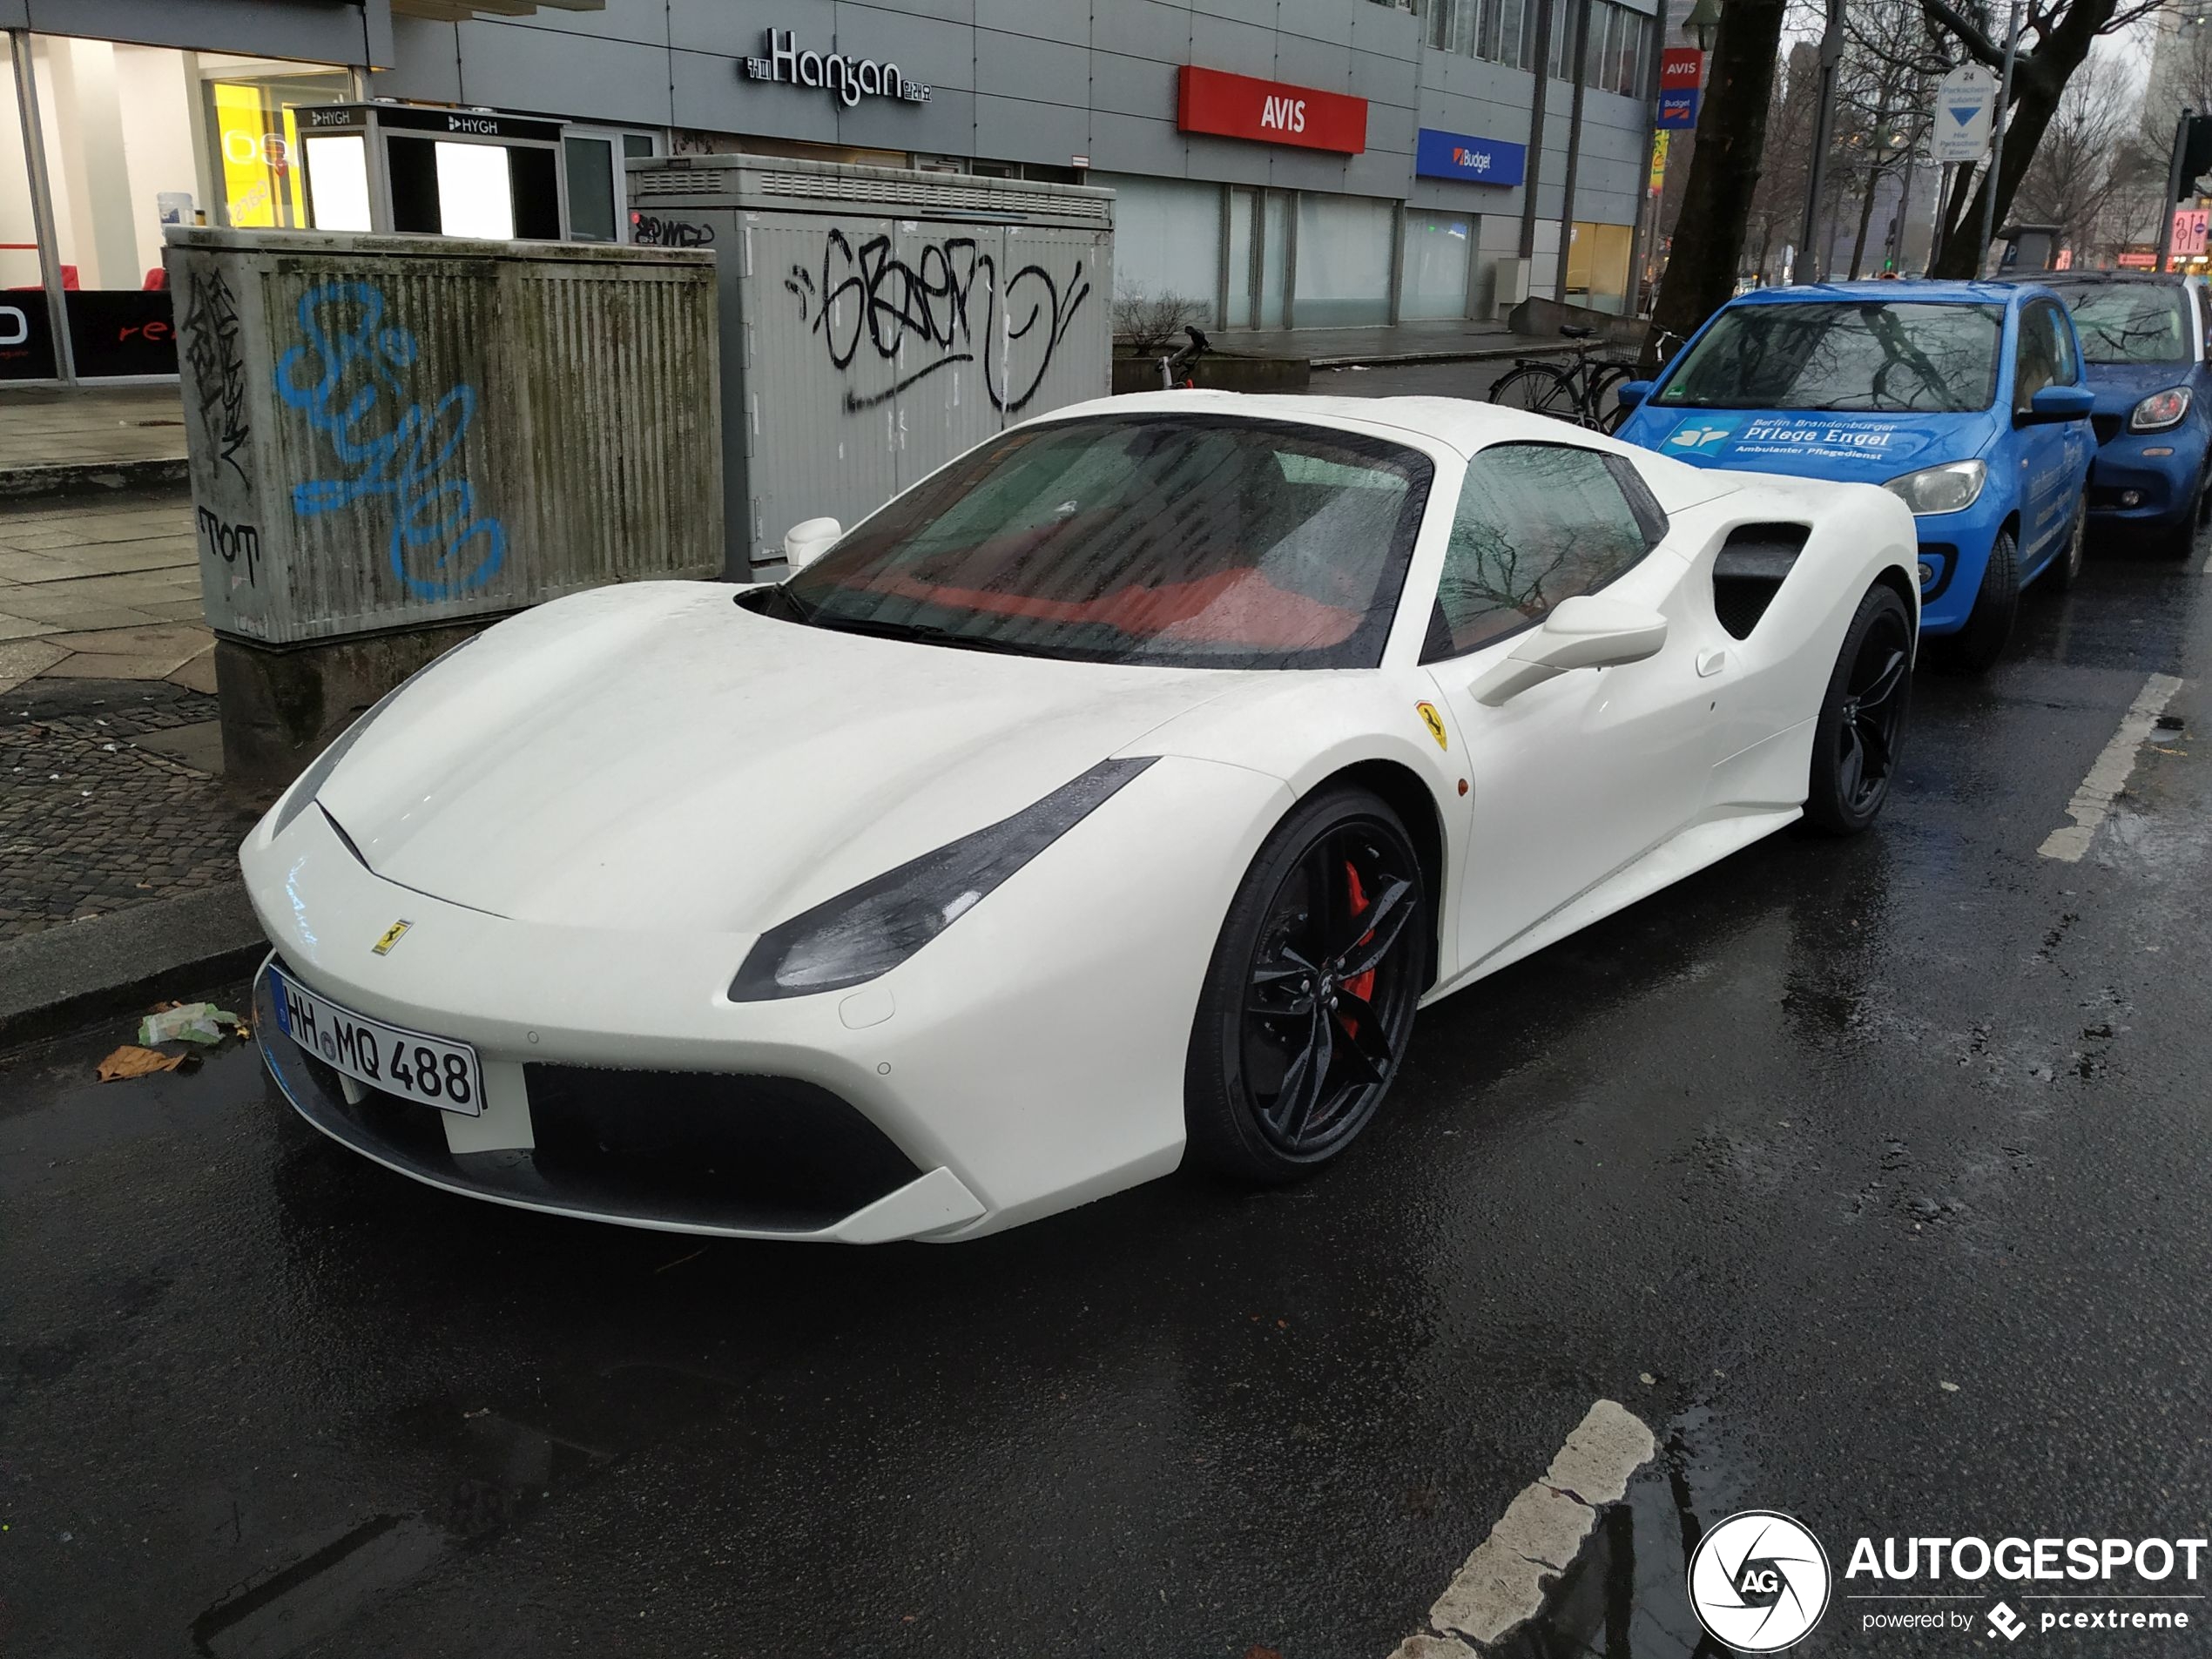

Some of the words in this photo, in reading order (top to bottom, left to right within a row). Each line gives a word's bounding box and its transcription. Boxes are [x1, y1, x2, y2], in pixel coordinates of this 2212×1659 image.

[768, 27, 902, 107] Hanjan
[1667, 63, 1696, 74] AVIS
[1963, 71, 1974, 81] 24
[1665, 99, 1690, 109] Budget
[322, 111, 350, 125] HYGH
[1261, 94, 1305, 133] AVIS
[462, 118, 498, 134] HYGH
[1464, 149, 1491, 173] Budget
[1753, 418, 1791, 427] Berlin
[1795, 419, 1897, 432] Brandenburger
[1744, 427, 1817, 442] Pflege
[1823, 428, 1892, 446] Engel
[1736, 445, 1804, 455] Ambulanter
[1807, 447, 1882, 461] Pflegedienst
[284, 984, 319, 1050] HH
[334, 1015, 382, 1082] MQ
[390, 1041, 471, 1104] 488
